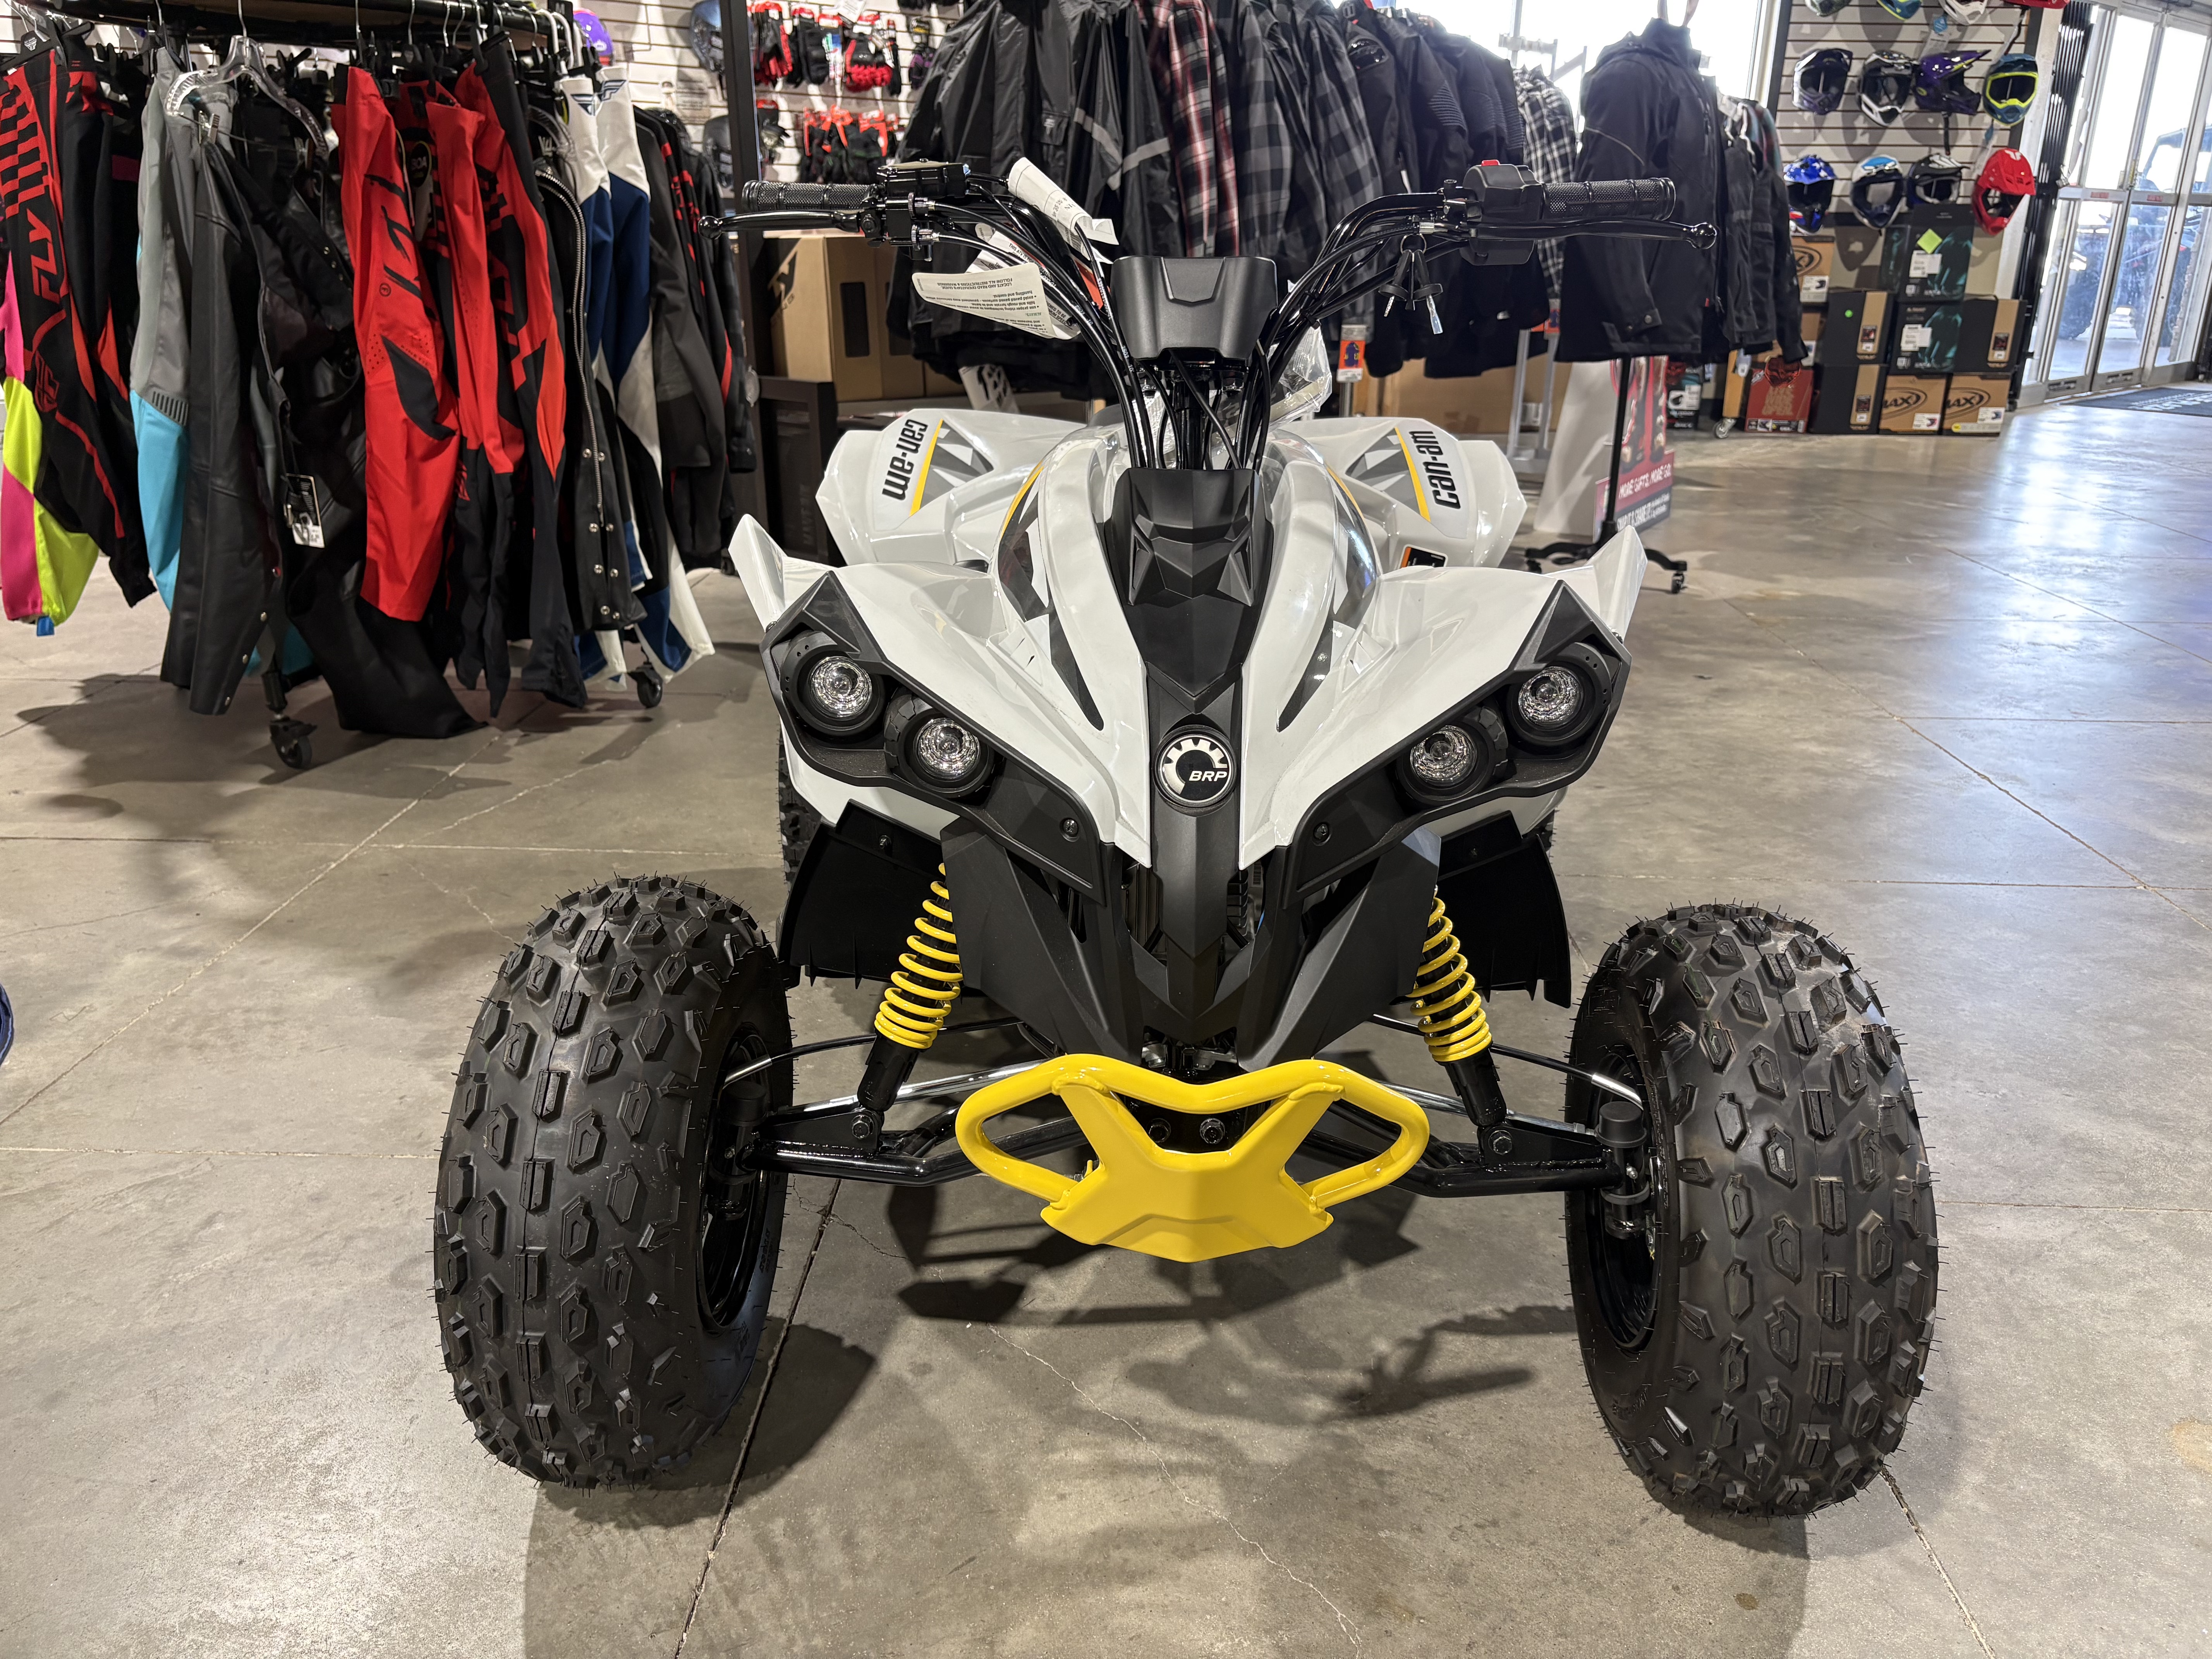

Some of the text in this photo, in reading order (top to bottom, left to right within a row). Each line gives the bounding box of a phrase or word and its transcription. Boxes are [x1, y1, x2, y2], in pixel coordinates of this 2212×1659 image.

[26, 209, 60, 304] FLY
[882, 419, 928, 501] can-am
[1409, 430, 1461, 510] can-am
[1619, 479, 1634, 499] MORE
[1650, 465, 1663, 483] MORE
[1189, 771, 1228, 781] BRP
